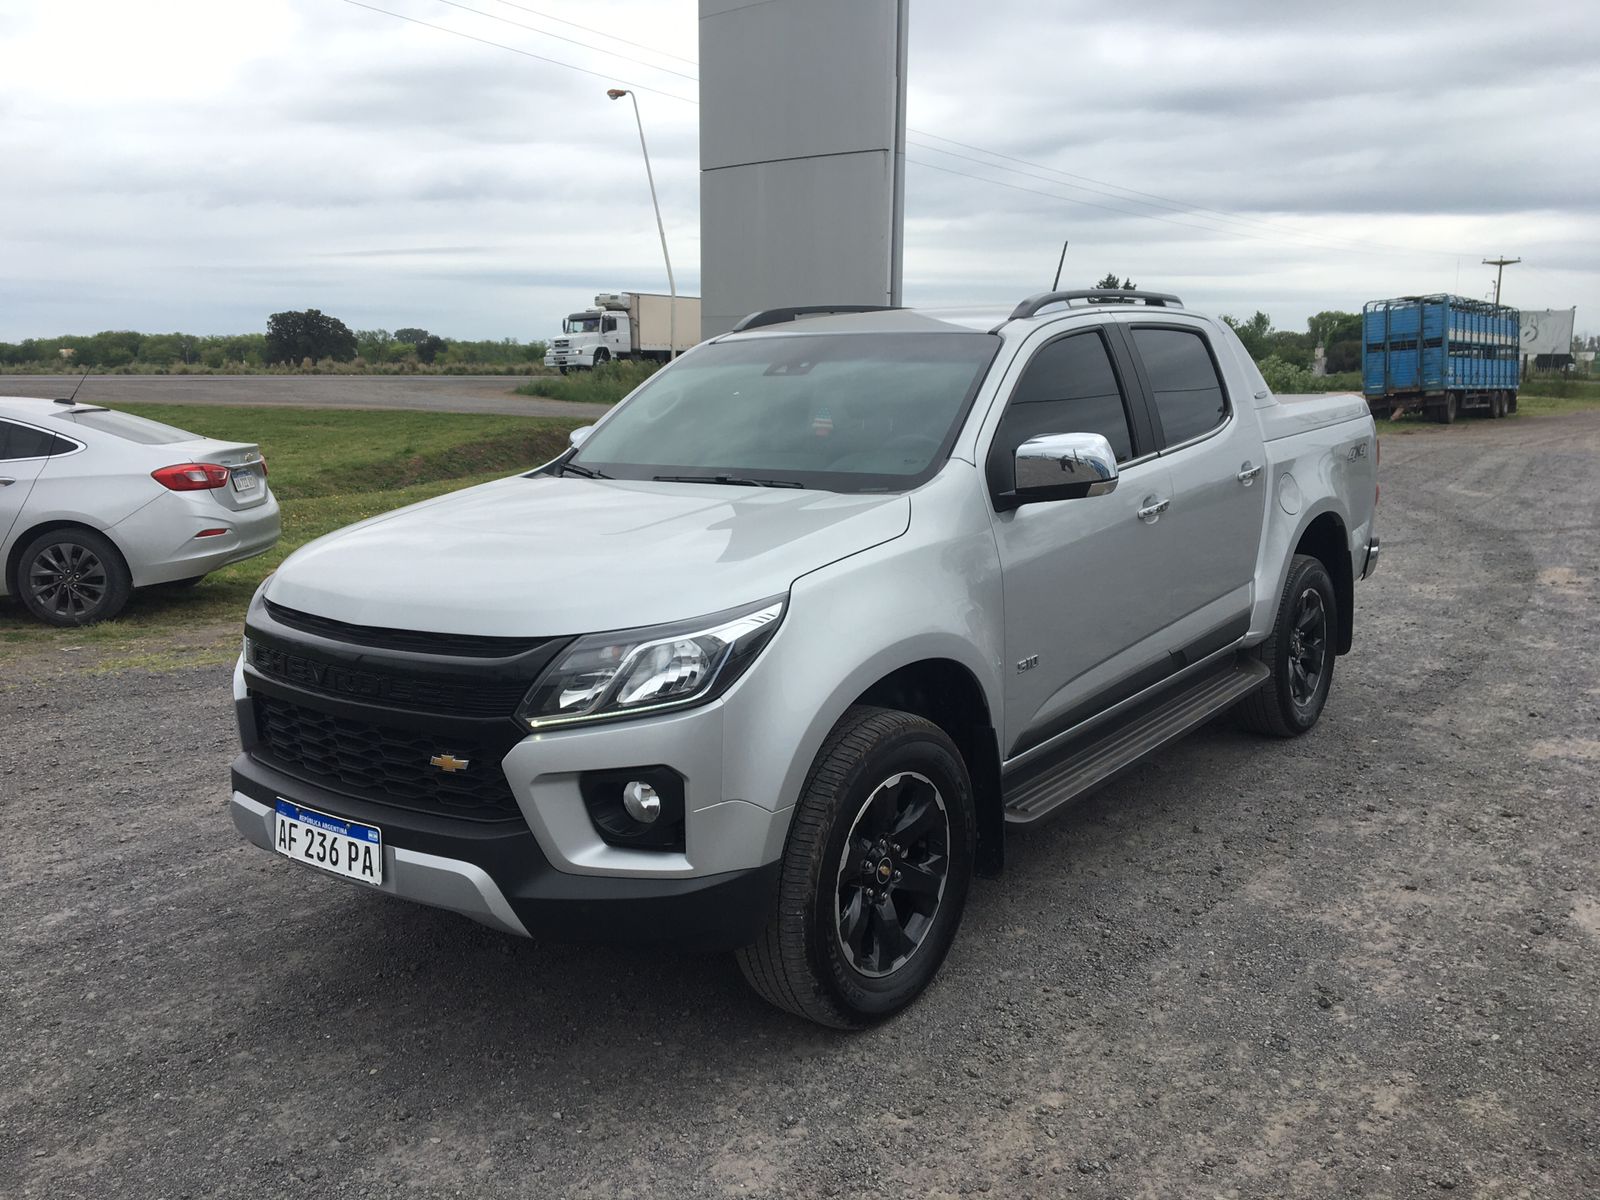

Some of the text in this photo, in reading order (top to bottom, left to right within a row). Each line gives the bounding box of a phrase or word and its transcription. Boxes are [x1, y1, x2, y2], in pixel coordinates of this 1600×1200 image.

[322, 822, 348, 835] ARGENTINA
[279, 819, 374, 877] AF 236 PA
